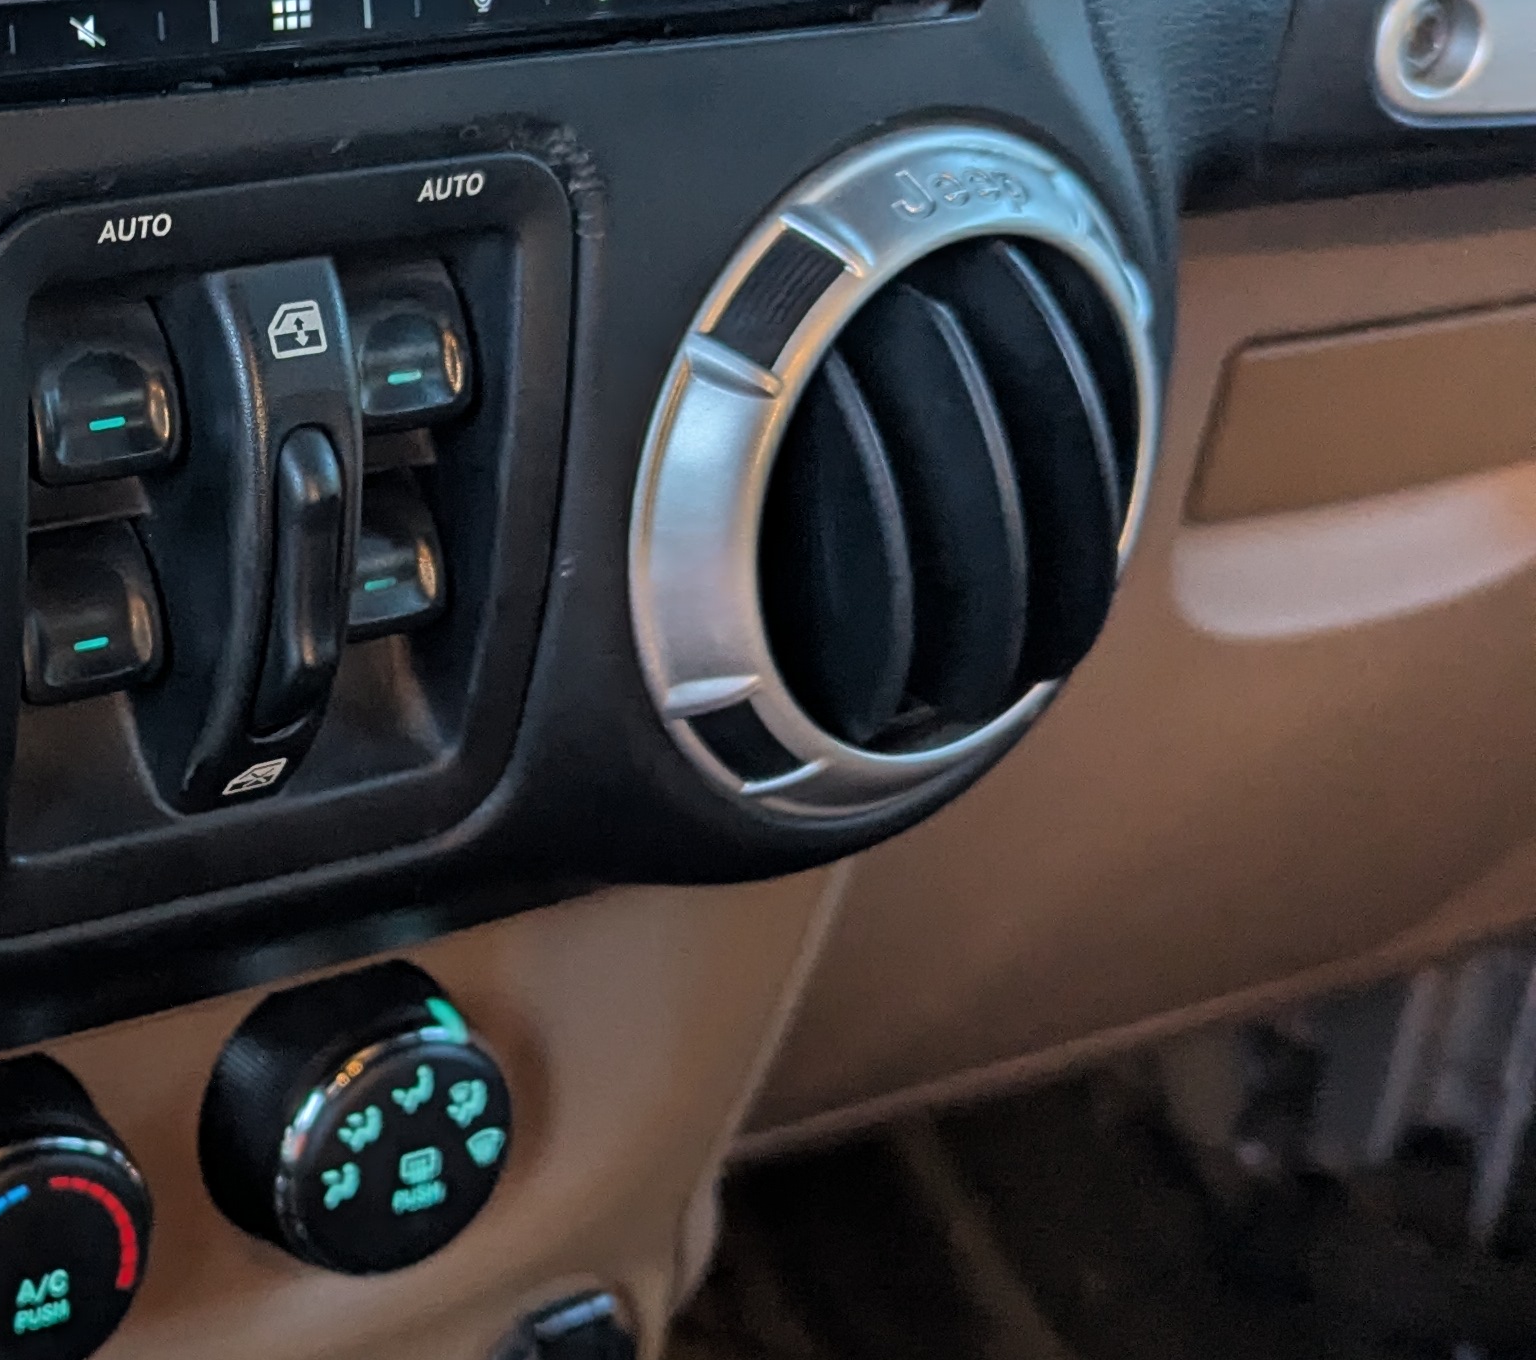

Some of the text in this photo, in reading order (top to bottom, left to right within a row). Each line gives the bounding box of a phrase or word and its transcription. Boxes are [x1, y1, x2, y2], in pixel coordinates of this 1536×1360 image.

[418, 172, 485, 203] AUTO
[892, 168, 1031, 222] Jeep
[98, 213, 173, 244] AUTO
[393, 1181, 446, 1213] PUSH
[16, 1269, 69, 1305] A/C
[14, 1299, 70, 1334] PUSH
